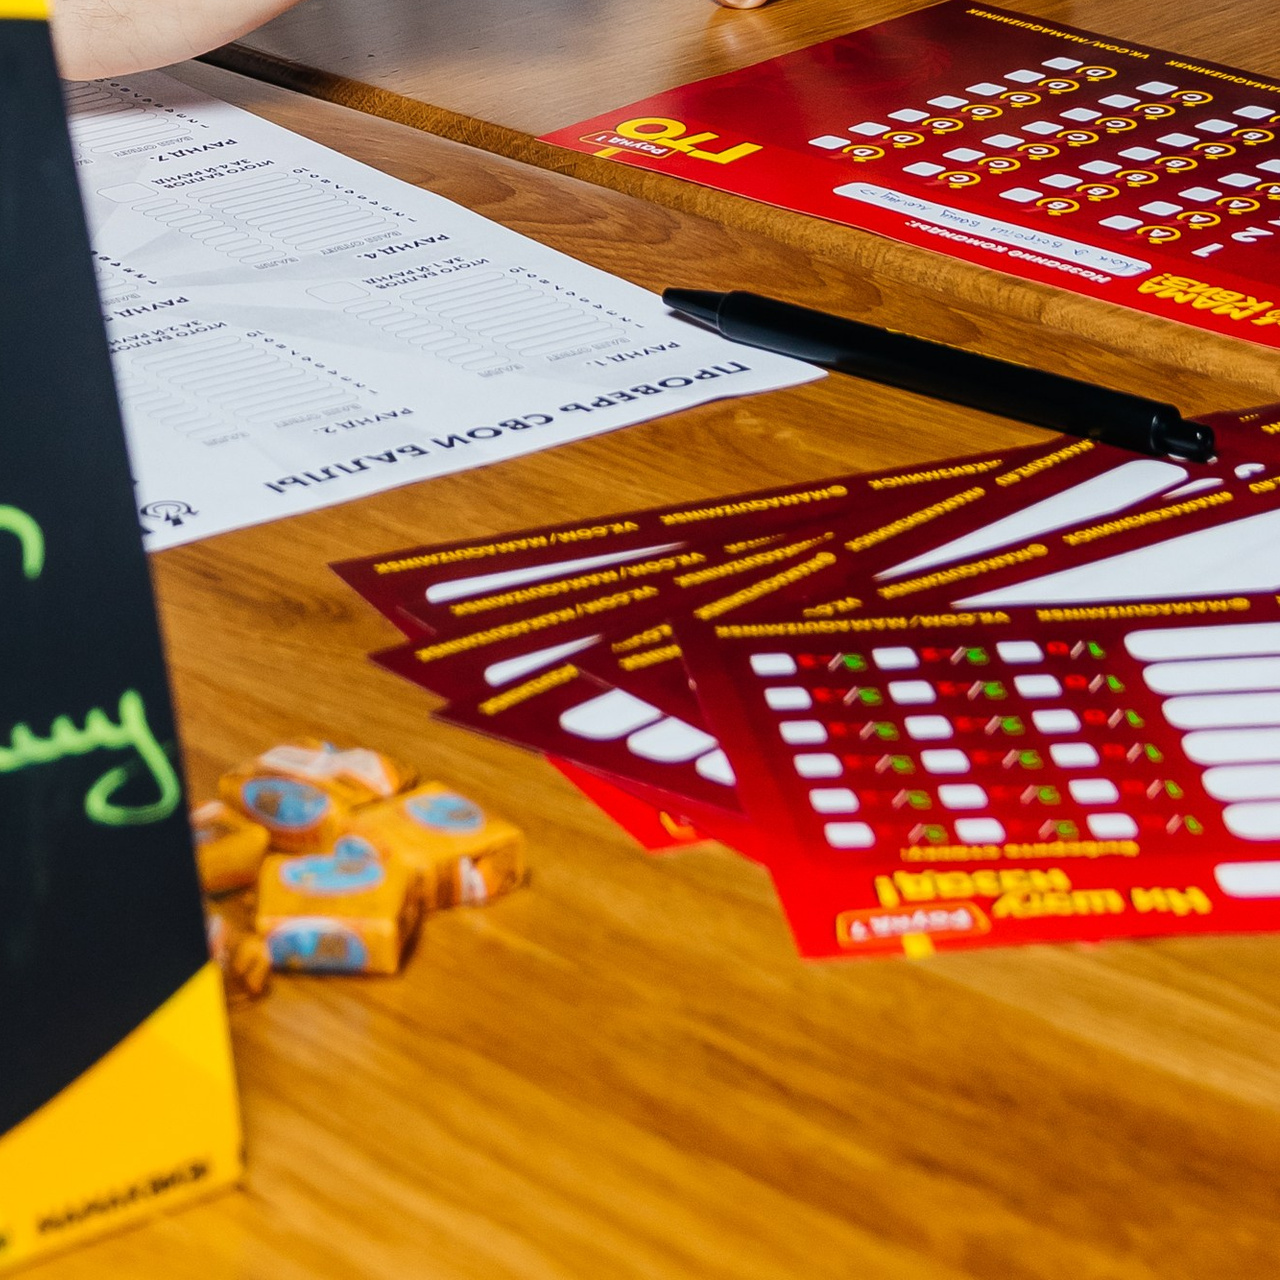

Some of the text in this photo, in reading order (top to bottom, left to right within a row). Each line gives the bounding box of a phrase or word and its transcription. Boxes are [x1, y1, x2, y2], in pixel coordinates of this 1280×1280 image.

[168, 139, 237, 157] РАУНД
[616, 117, 763, 164] ГТО
[151, 170, 203, 185] РАУНД
[163, 160, 275, 189] ИТОГО БАЛЛОВ
[378, 234, 449, 255] РАУНД
[1231, 227, 1274, 243] 2
[1192, 243, 1223, 257] 1
[361, 270, 416, 285] РАУНД
[375, 259, 490, 289] ИТОГО БАЛЛОВ
[1008, 249, 1112, 284] Название
[1137, 279, 1255, 320] МАМА
[1149, 273, 1274, 313] КВИЗ!
[114, 297, 189, 317] РАУНД
[109, 333, 150, 346] РАУН
[175, 322, 227, 337] ИТОГО
[607, 340, 681, 362] РАУНД
[265, 362, 751, 493] ПРОВЕРЬ СВОИ БАЛЛЫ
[337, 408, 414, 432] РАУНД
[868, 459, 1001, 491] АКВИЗМИНСК
